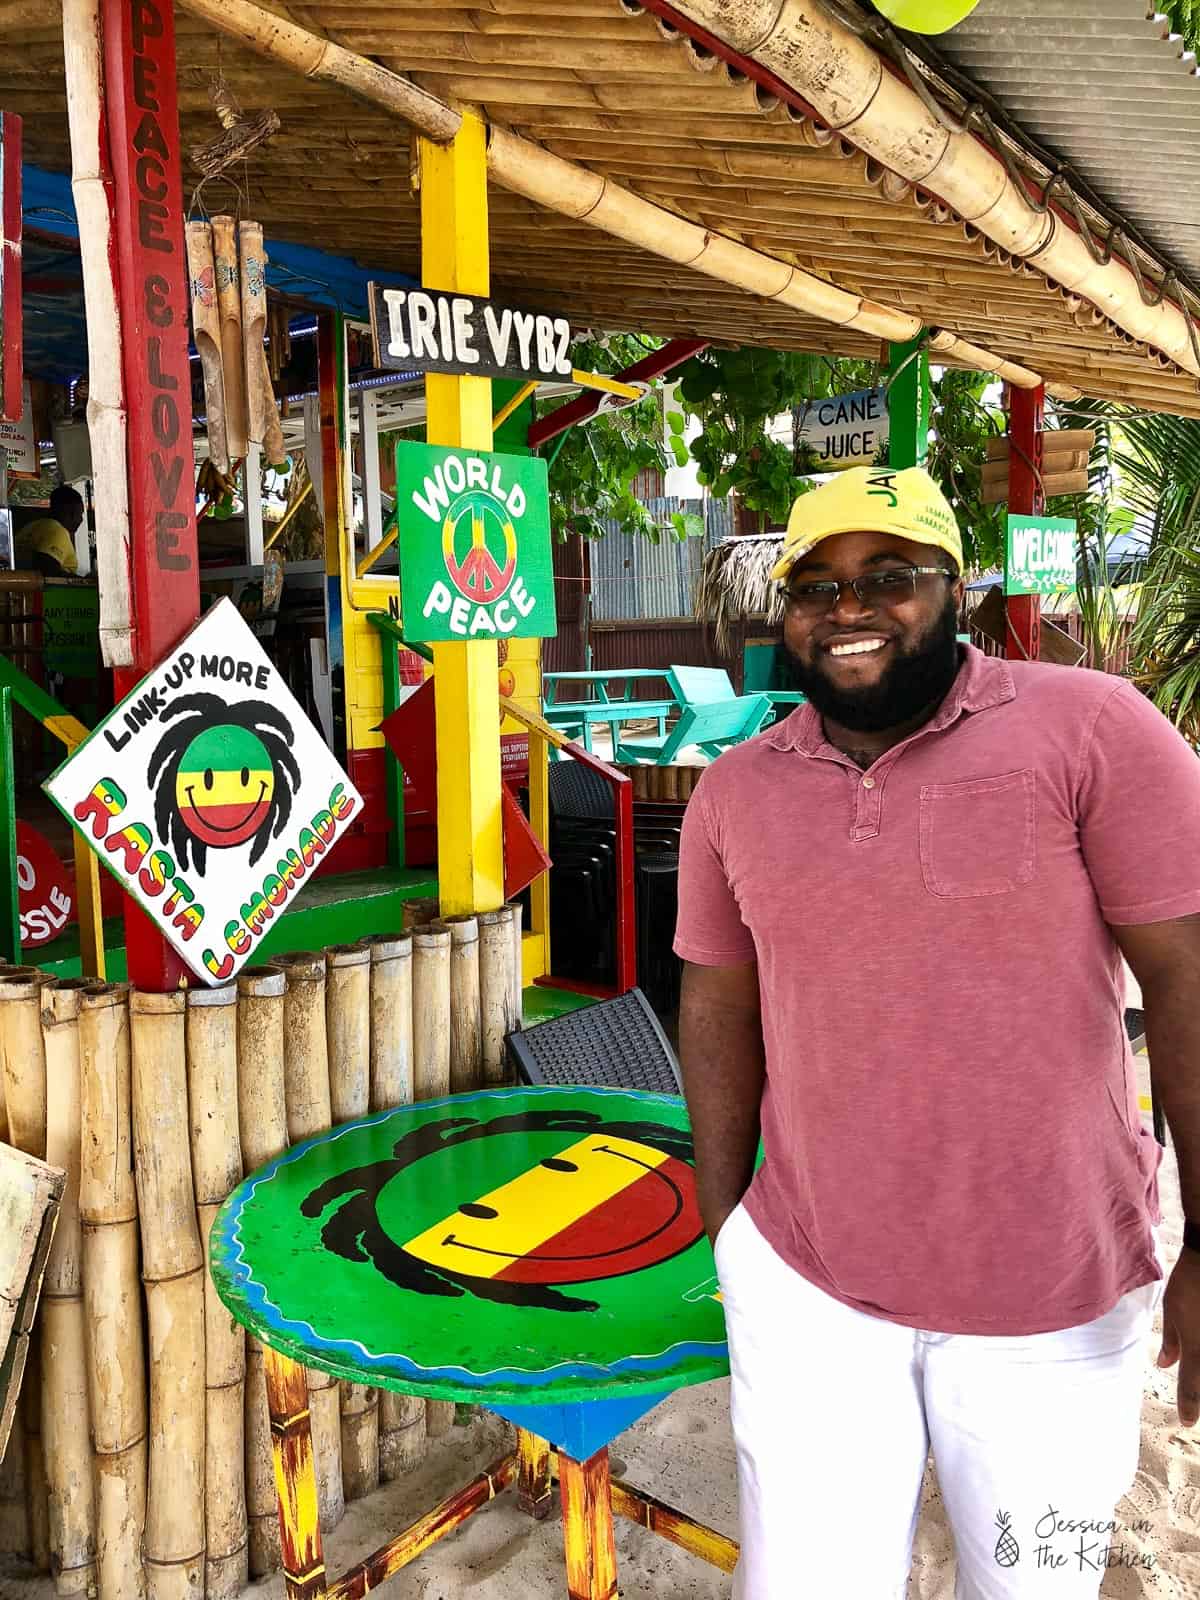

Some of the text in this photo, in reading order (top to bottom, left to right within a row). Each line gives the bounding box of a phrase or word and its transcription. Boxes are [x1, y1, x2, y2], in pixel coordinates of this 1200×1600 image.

[131, 0, 175, 254] PEACE
[383, 288, 573, 375] IRIE VYBZ
[147, 336, 192, 572] LOVE
[818, 394, 881, 426] CANE
[820, 430, 875, 460] JUICE
[412, 454, 526, 523] WORLD
[422, 575, 537, 636] PEACE
[103, 652, 271, 752] LINK-UP MORE
[74, 777, 206, 942] RASTA
[202, 782, 356, 980] LEMONADE
